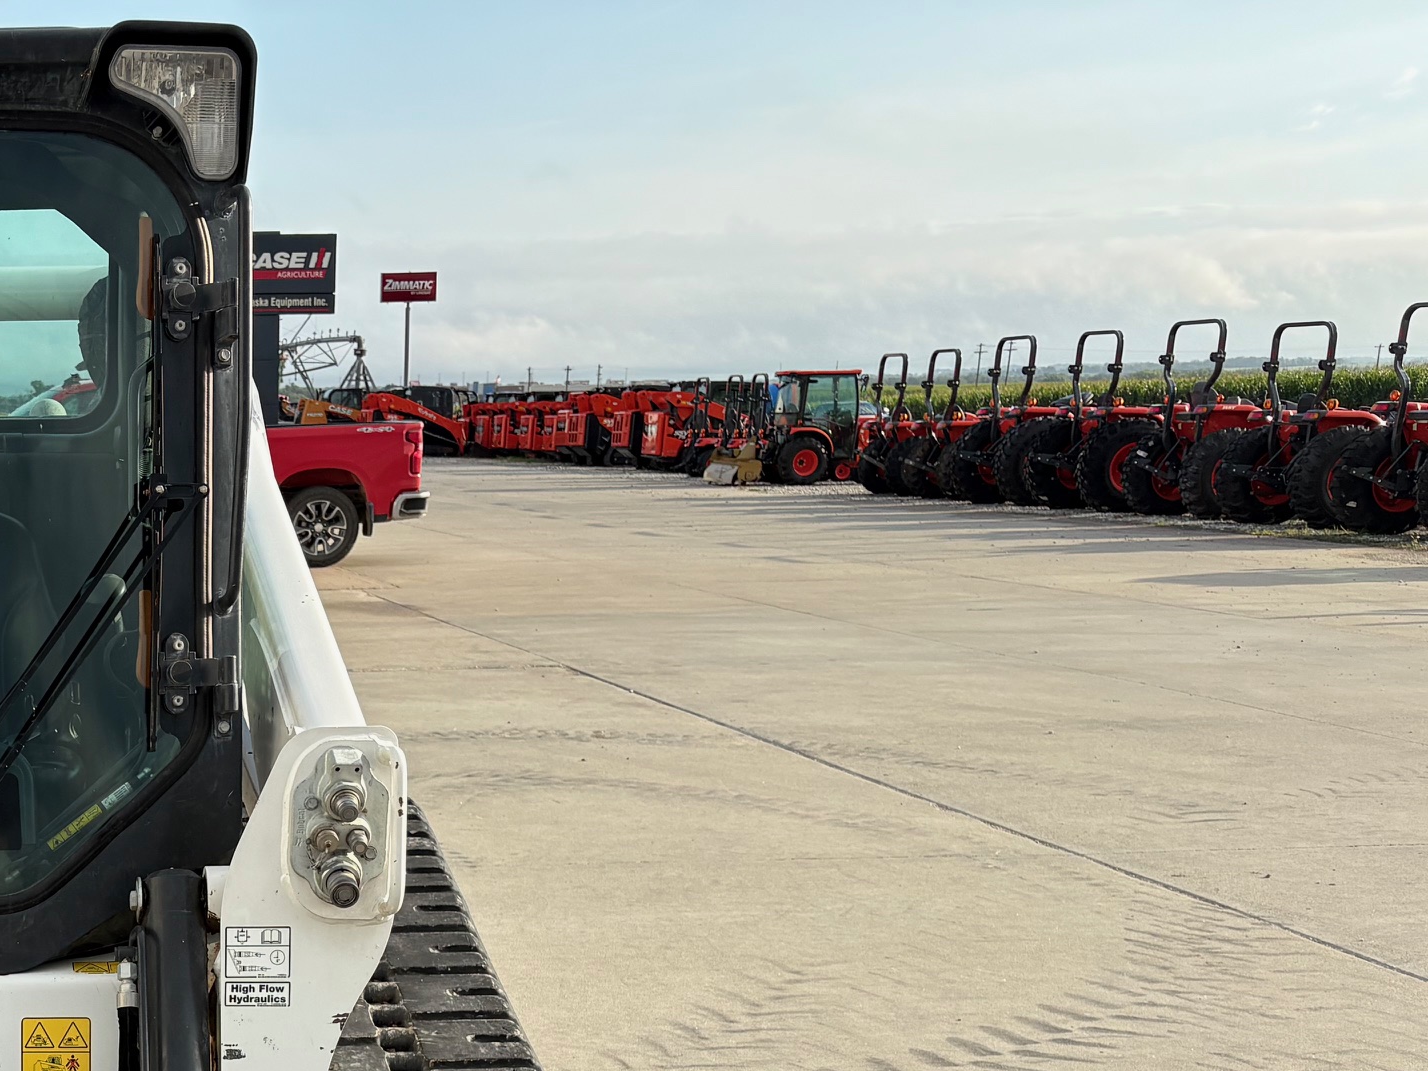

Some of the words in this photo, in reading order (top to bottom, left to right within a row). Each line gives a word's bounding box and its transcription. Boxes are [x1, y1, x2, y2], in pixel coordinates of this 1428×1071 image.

[271, 297, 312, 308] Equipment
[313, 297, 328, 307] Inc.
[328, 404, 353, 416] CASE
[230, 984, 255, 994] High
[258, 984, 285, 993] Flow
[229, 994, 287, 1004] Hydraulics
